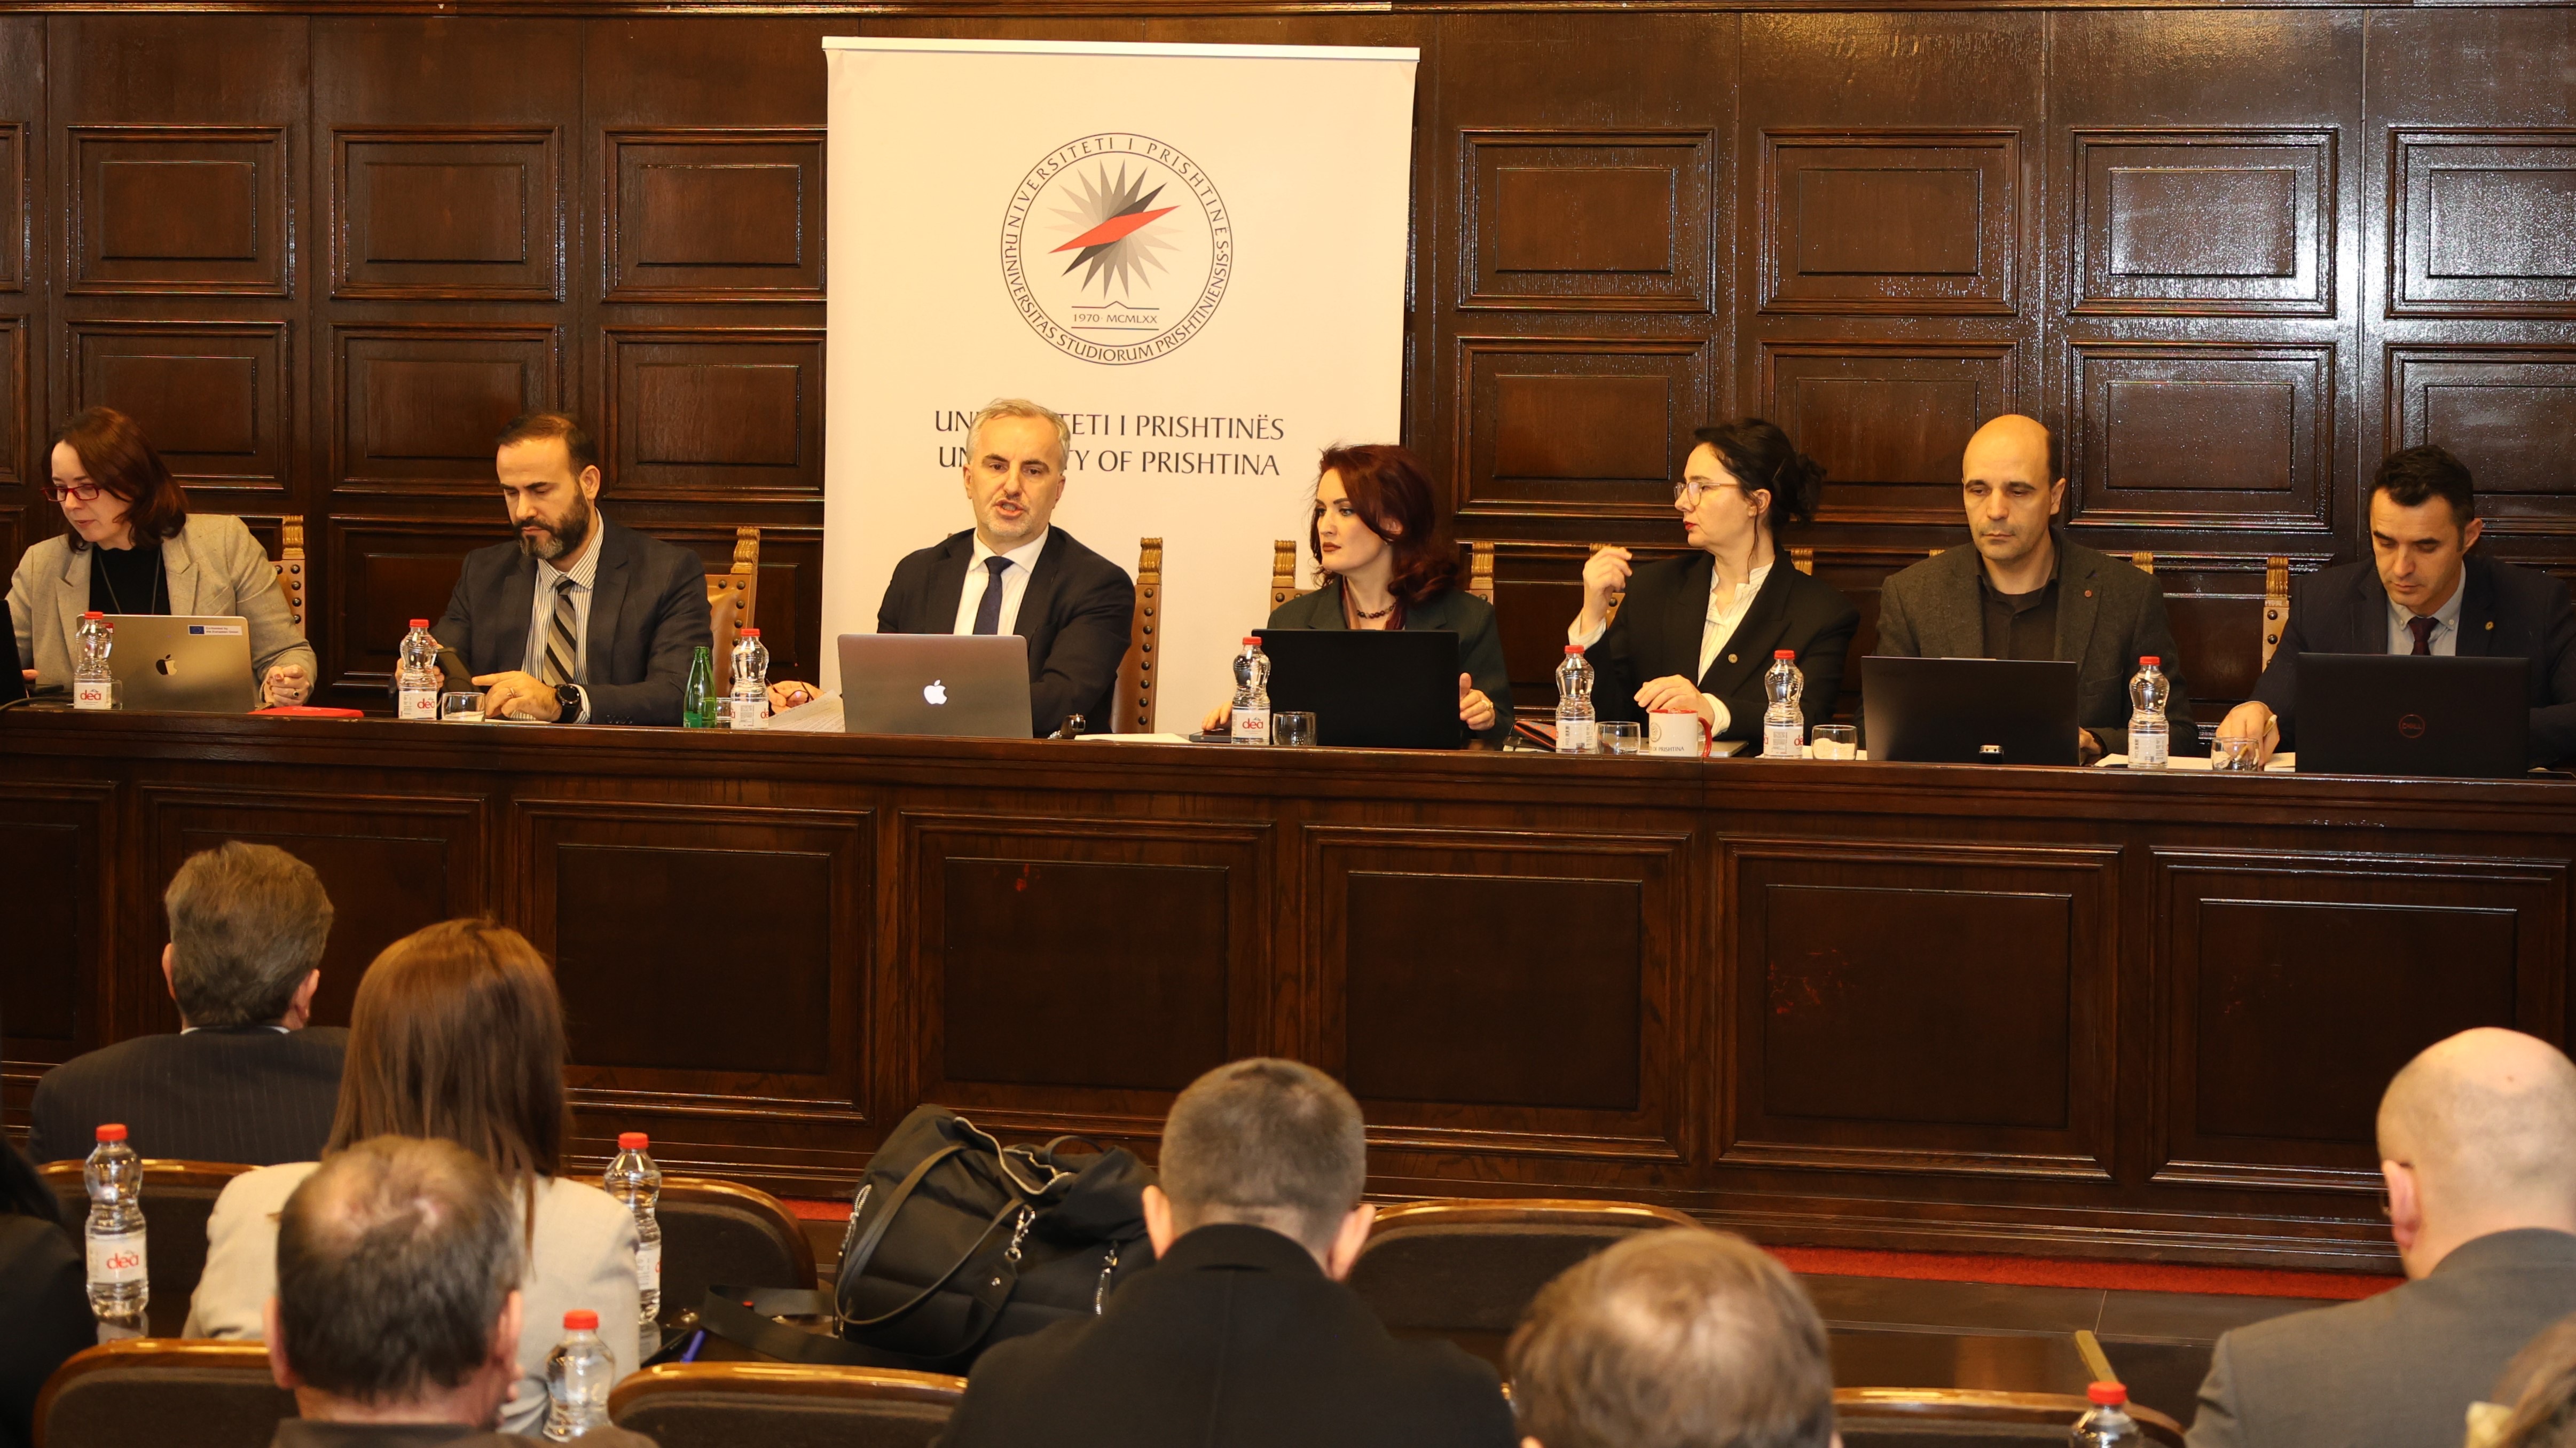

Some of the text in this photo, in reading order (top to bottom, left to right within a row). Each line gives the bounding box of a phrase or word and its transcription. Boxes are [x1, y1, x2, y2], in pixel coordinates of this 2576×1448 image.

[1006, 137, 1229, 250] UNIVERSITETI I PRISHTINËS
[1004, 247, 1229, 361] UNIVERSITAS STUDIORUM PRISHTINIENSIS
[1073, 313, 1158, 324] 1970 MCMLXX
[1120, 415, 1125, 436] I
[1136, 414, 1284, 440] PRISHTINËS
[1098, 450, 1133, 472] OF
[1142, 451, 1280, 476] PRISHTINA
